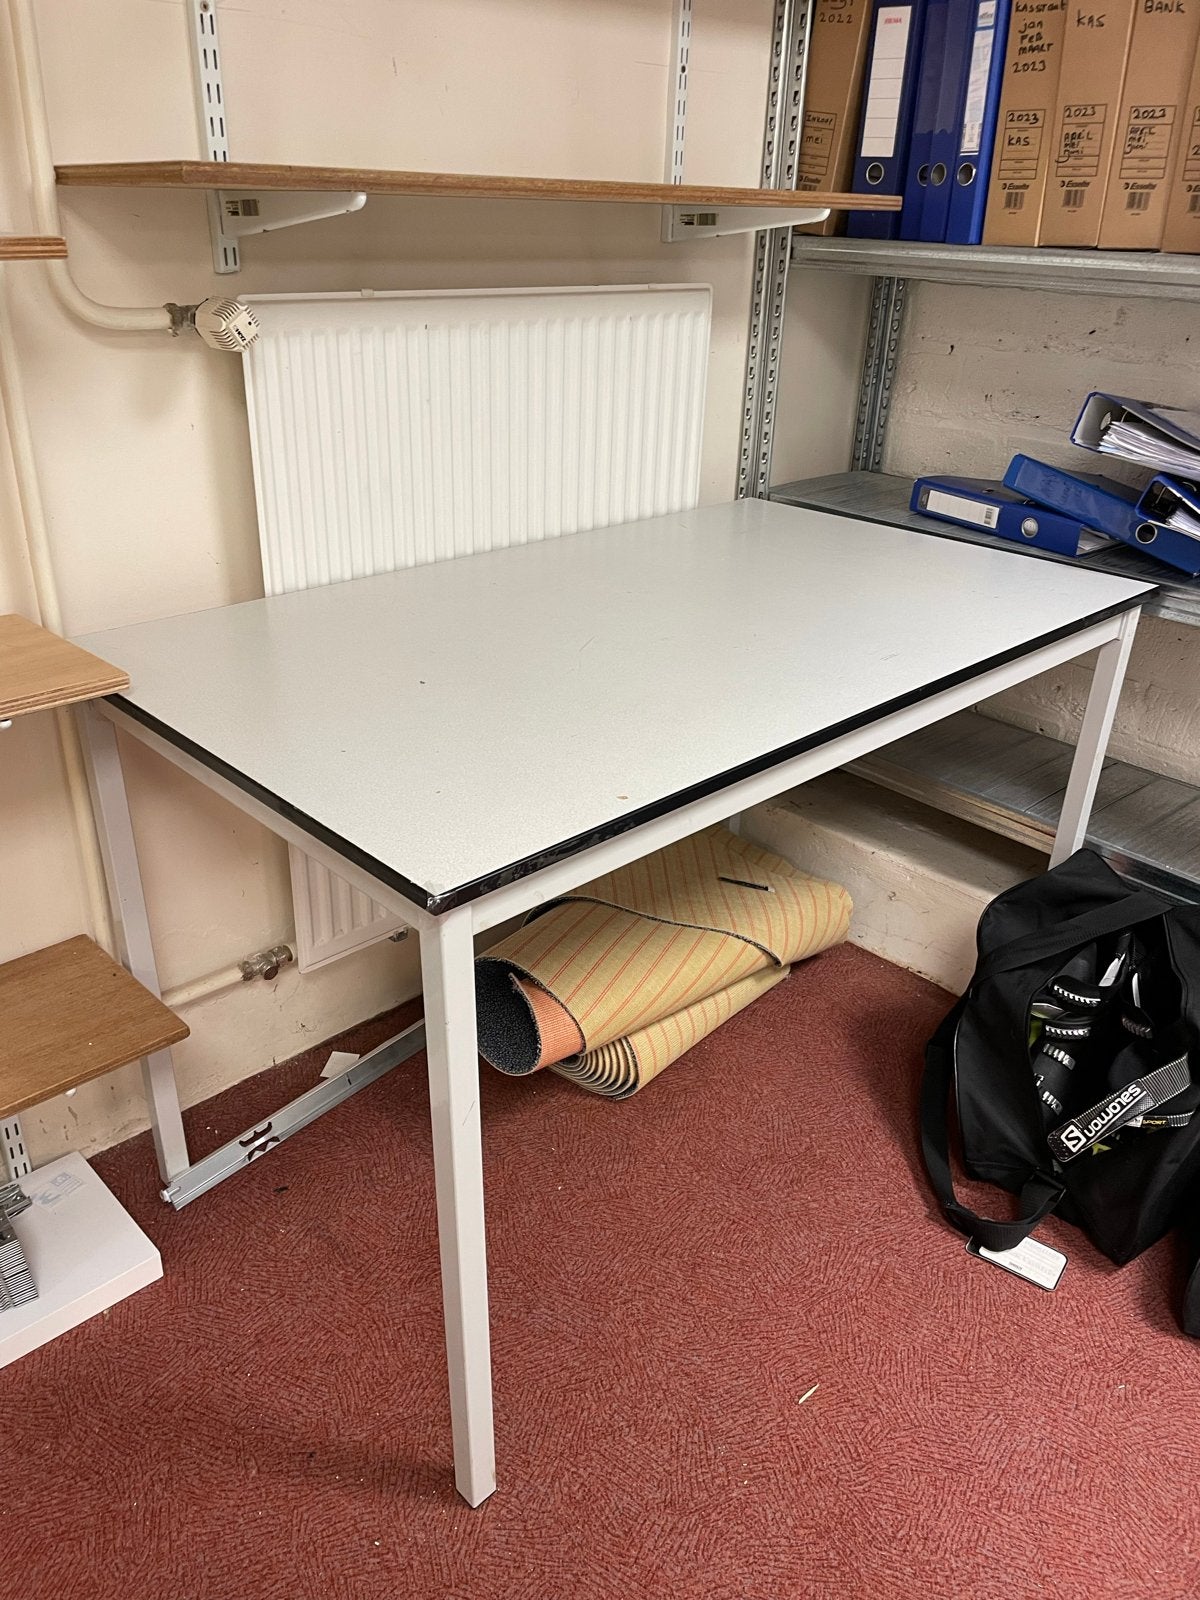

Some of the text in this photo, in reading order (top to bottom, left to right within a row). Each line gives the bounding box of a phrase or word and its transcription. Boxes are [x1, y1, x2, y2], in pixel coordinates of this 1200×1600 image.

[819, 12, 852, 23] 2022
[1012, 60, 1046, 73] 2023
[1064, 106, 1096, 118] 2023
[1132, 108, 1166, 119] 2023
[1008, 112, 1040, 125] 2023
[1007, 135, 1030, 146] KAS
